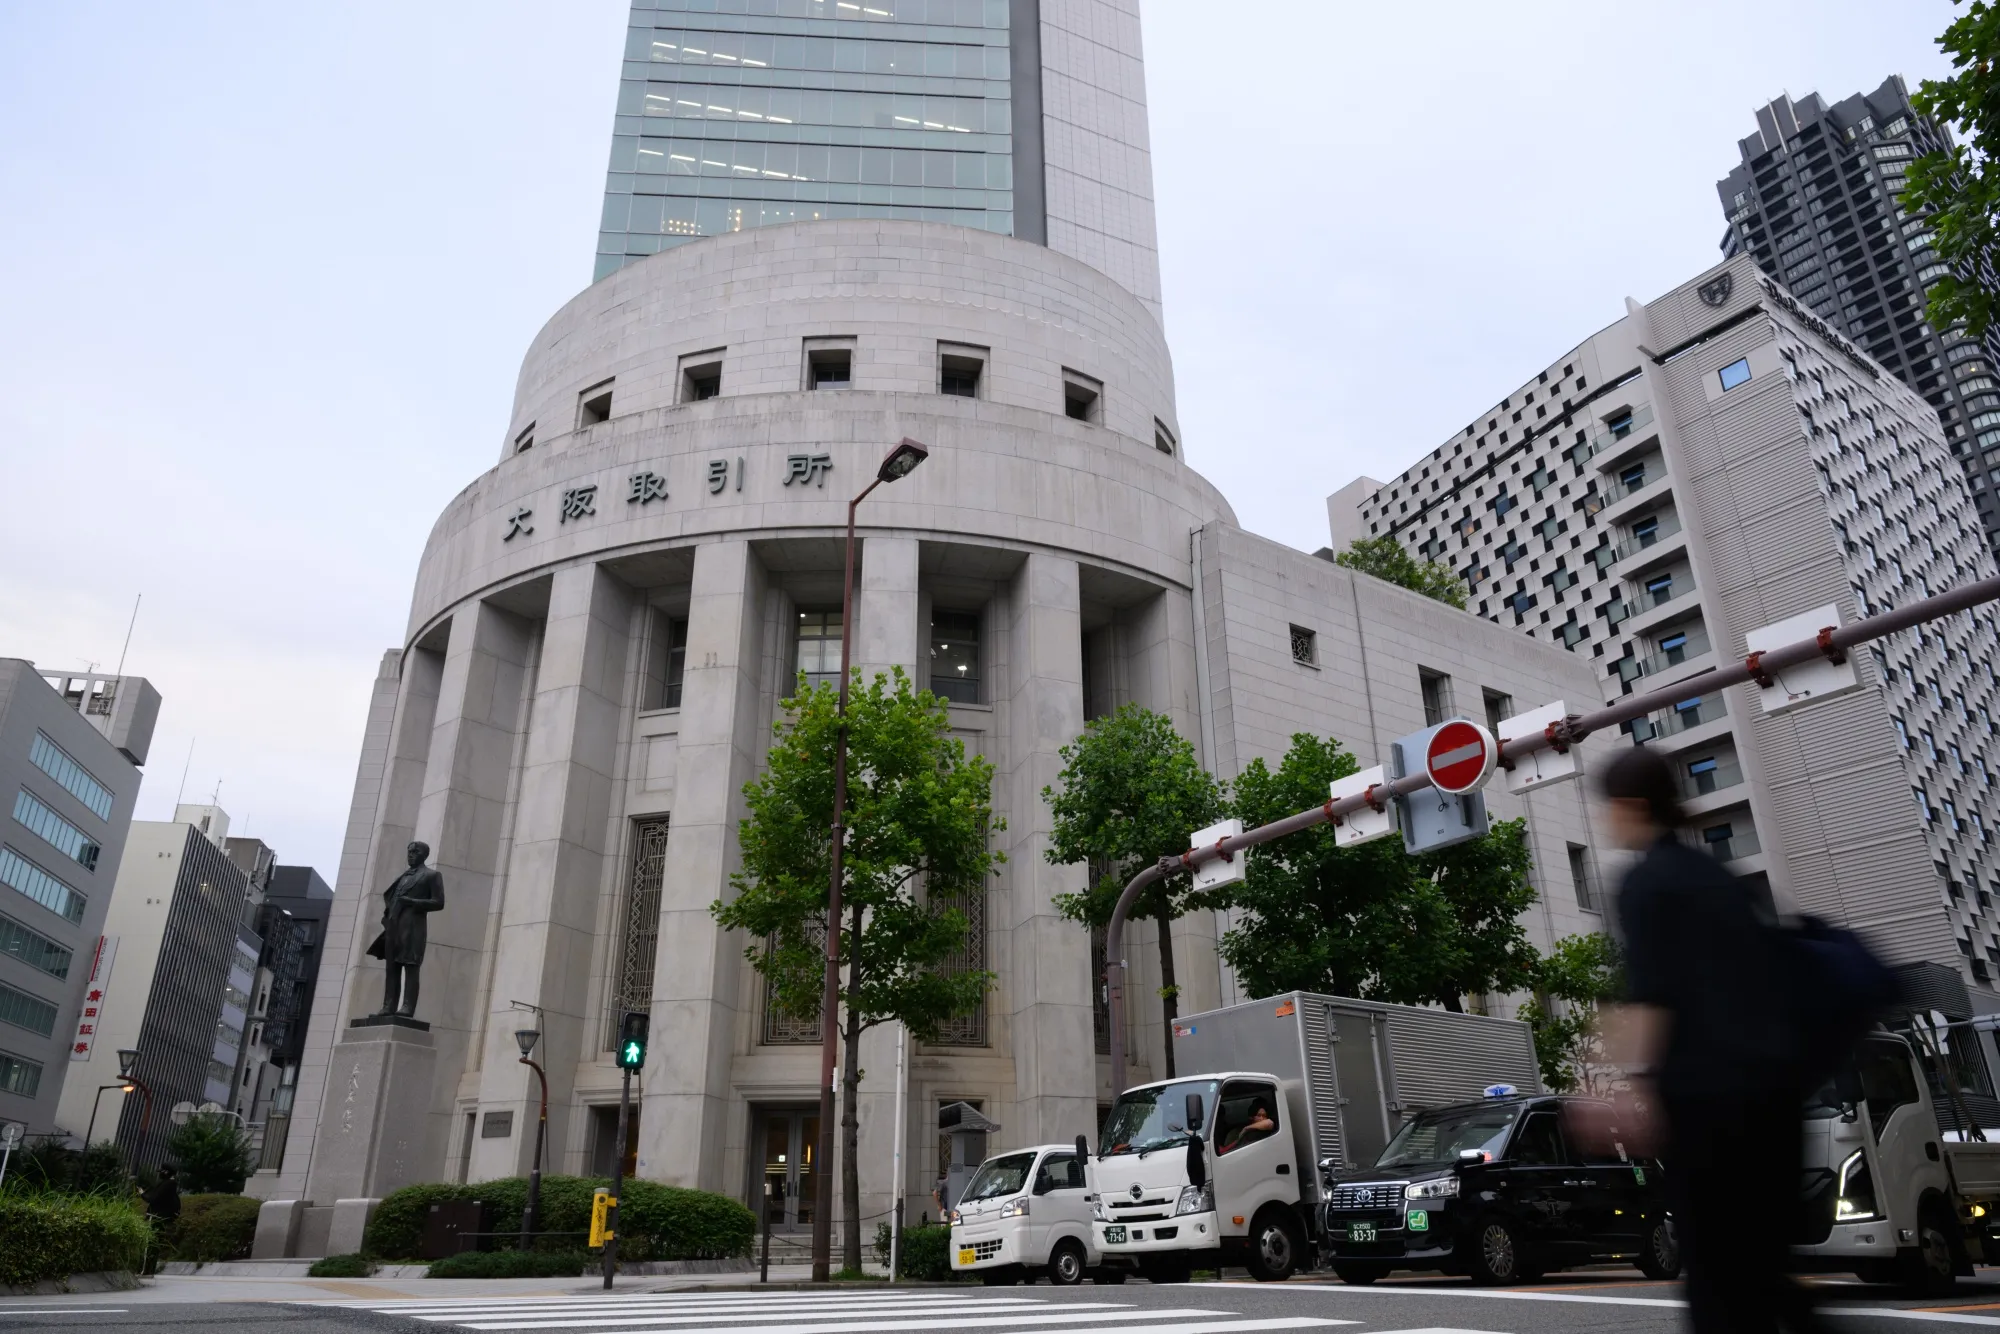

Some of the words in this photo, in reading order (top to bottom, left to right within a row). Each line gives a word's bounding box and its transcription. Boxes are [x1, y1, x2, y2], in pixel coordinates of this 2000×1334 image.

[1762, 278, 1789, 307] The
[1788, 297, 1819, 332] Royal
[1819, 321, 1845, 352] Park
[503, 452, 833, 542] 大阪取引所
